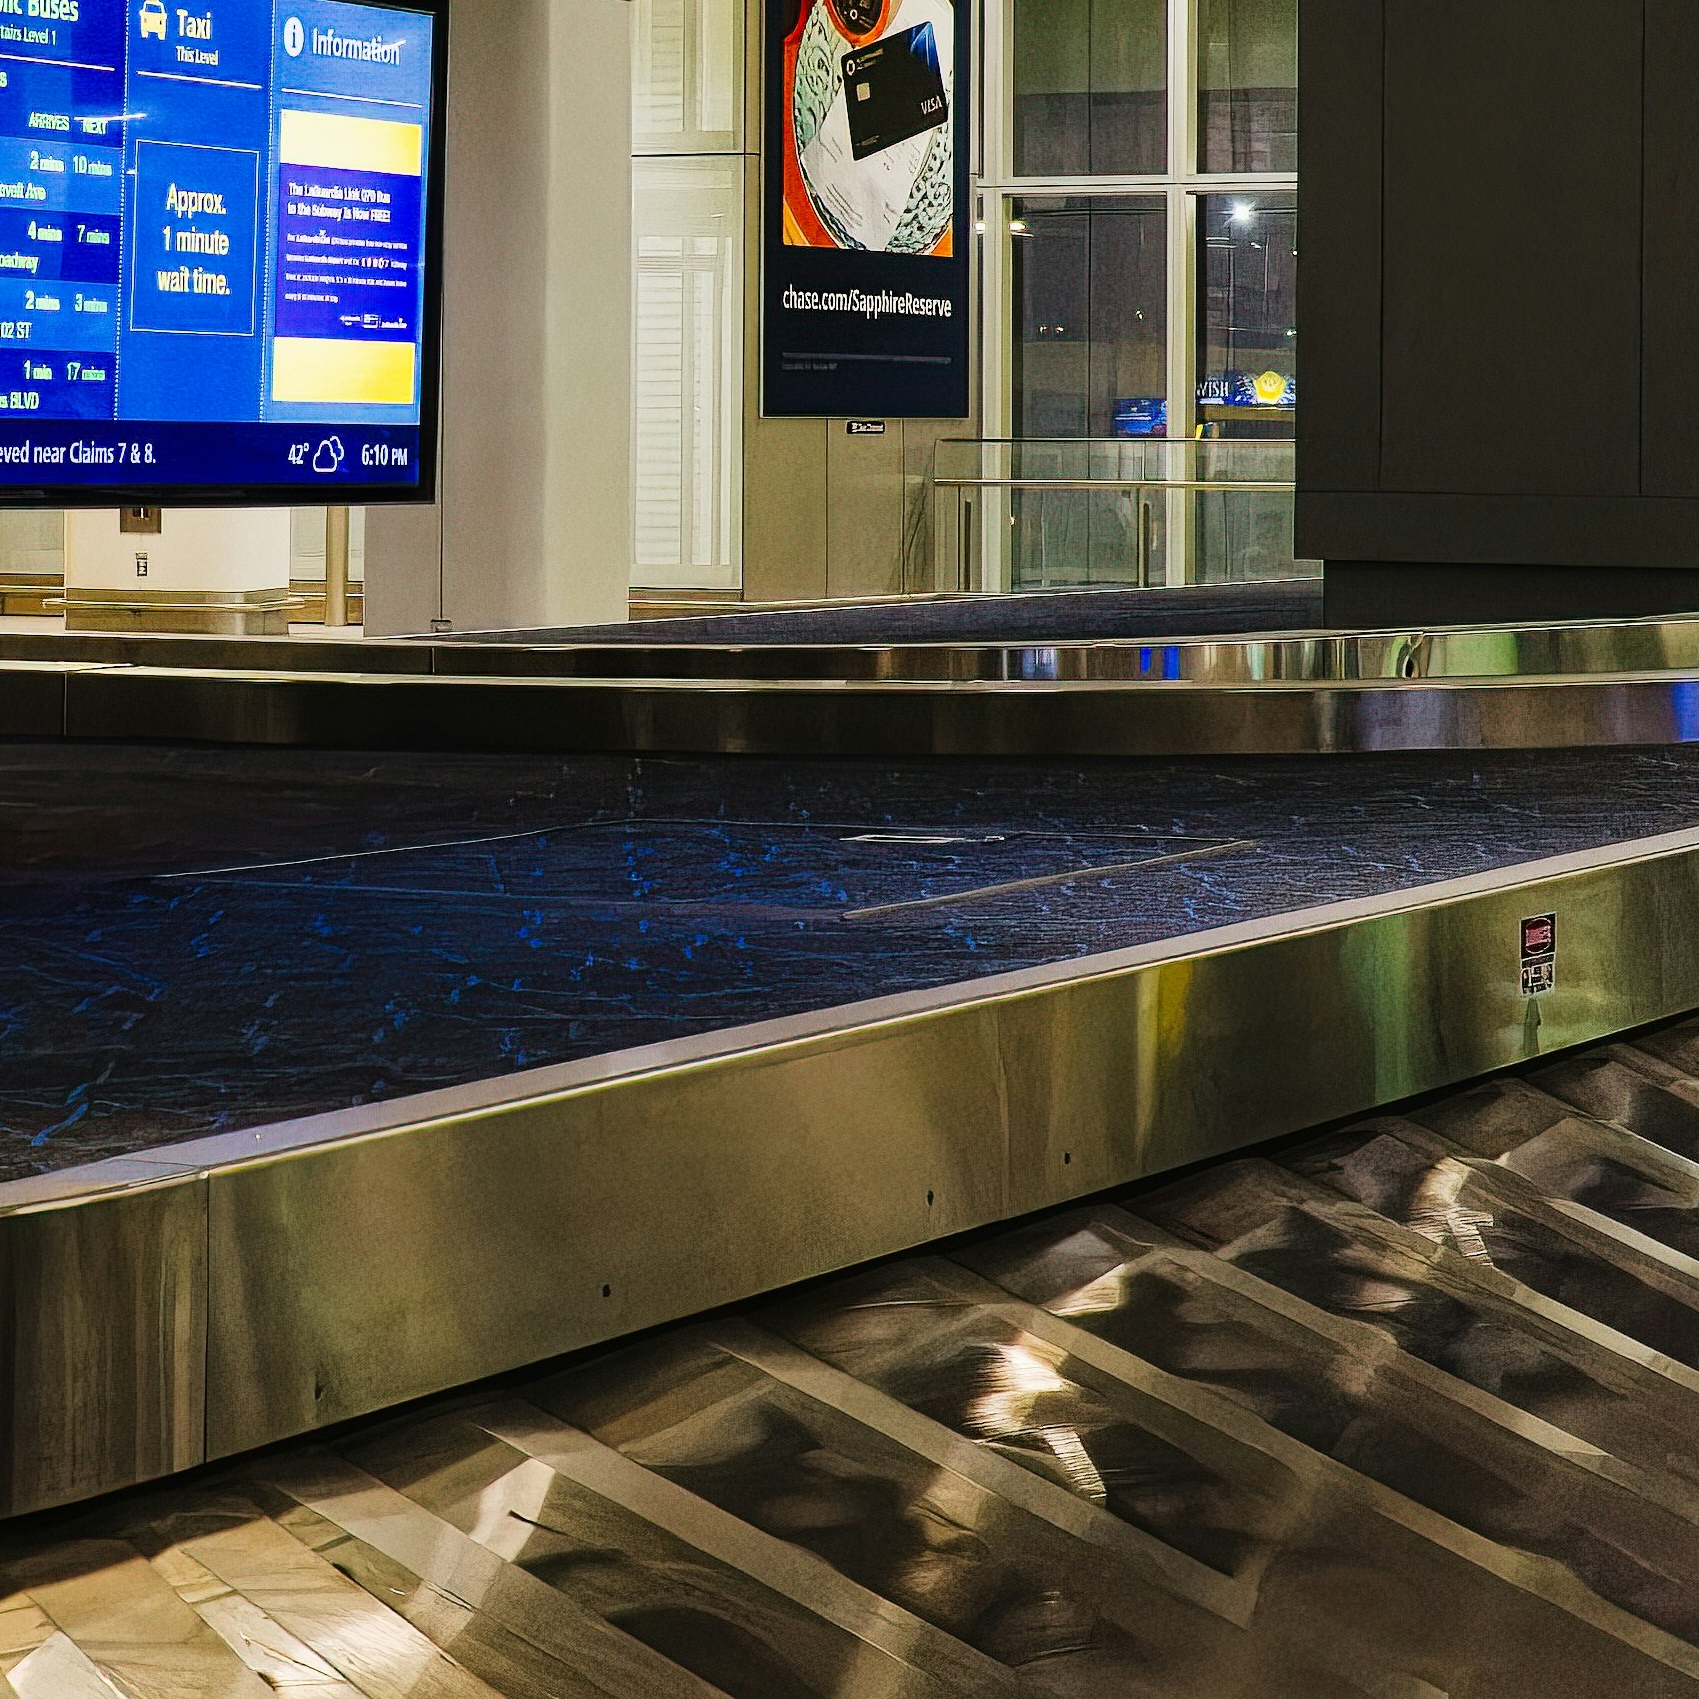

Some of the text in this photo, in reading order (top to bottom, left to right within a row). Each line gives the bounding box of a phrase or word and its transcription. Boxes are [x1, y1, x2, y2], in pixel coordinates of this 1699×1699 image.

[23, 25, 49, 45] Level
[51, 30, 57, 46] 1
[176, 8, 212, 40] Taxi
[175, 44, 219, 66] This Level
[312, 26, 400, 66] Information
[920, 95, 943, 115] VISA
[29, 150, 39, 171] 2
[73, 155, 88, 175] 10
[165, 182, 227, 219] Approx.
[27, 221, 37, 240] 4
[77, 224, 86, 243] 7
[162, 225, 230, 256] 1 minute
[157, 265, 231, 295] wait time.
[24, 290, 35, 310] 2
[74, 293, 83, 312] 3
[782, 283, 952, 320] chase.com/SapphireReserve
[16, 321, 33, 339] ST
[23, 359, 31, 380] 1
[66, 361, 82, 381] 17
[9, 391, 40, 410] BLVD
[33, 445, 67, 464] near
[69, 439, 114, 464] Claims
[118, 442, 128, 464] 7
[129, 442, 142, 464] &
[144, 442, 156, 464] 8.
[287, 442, 408, 466] 42° 6:10 PM
